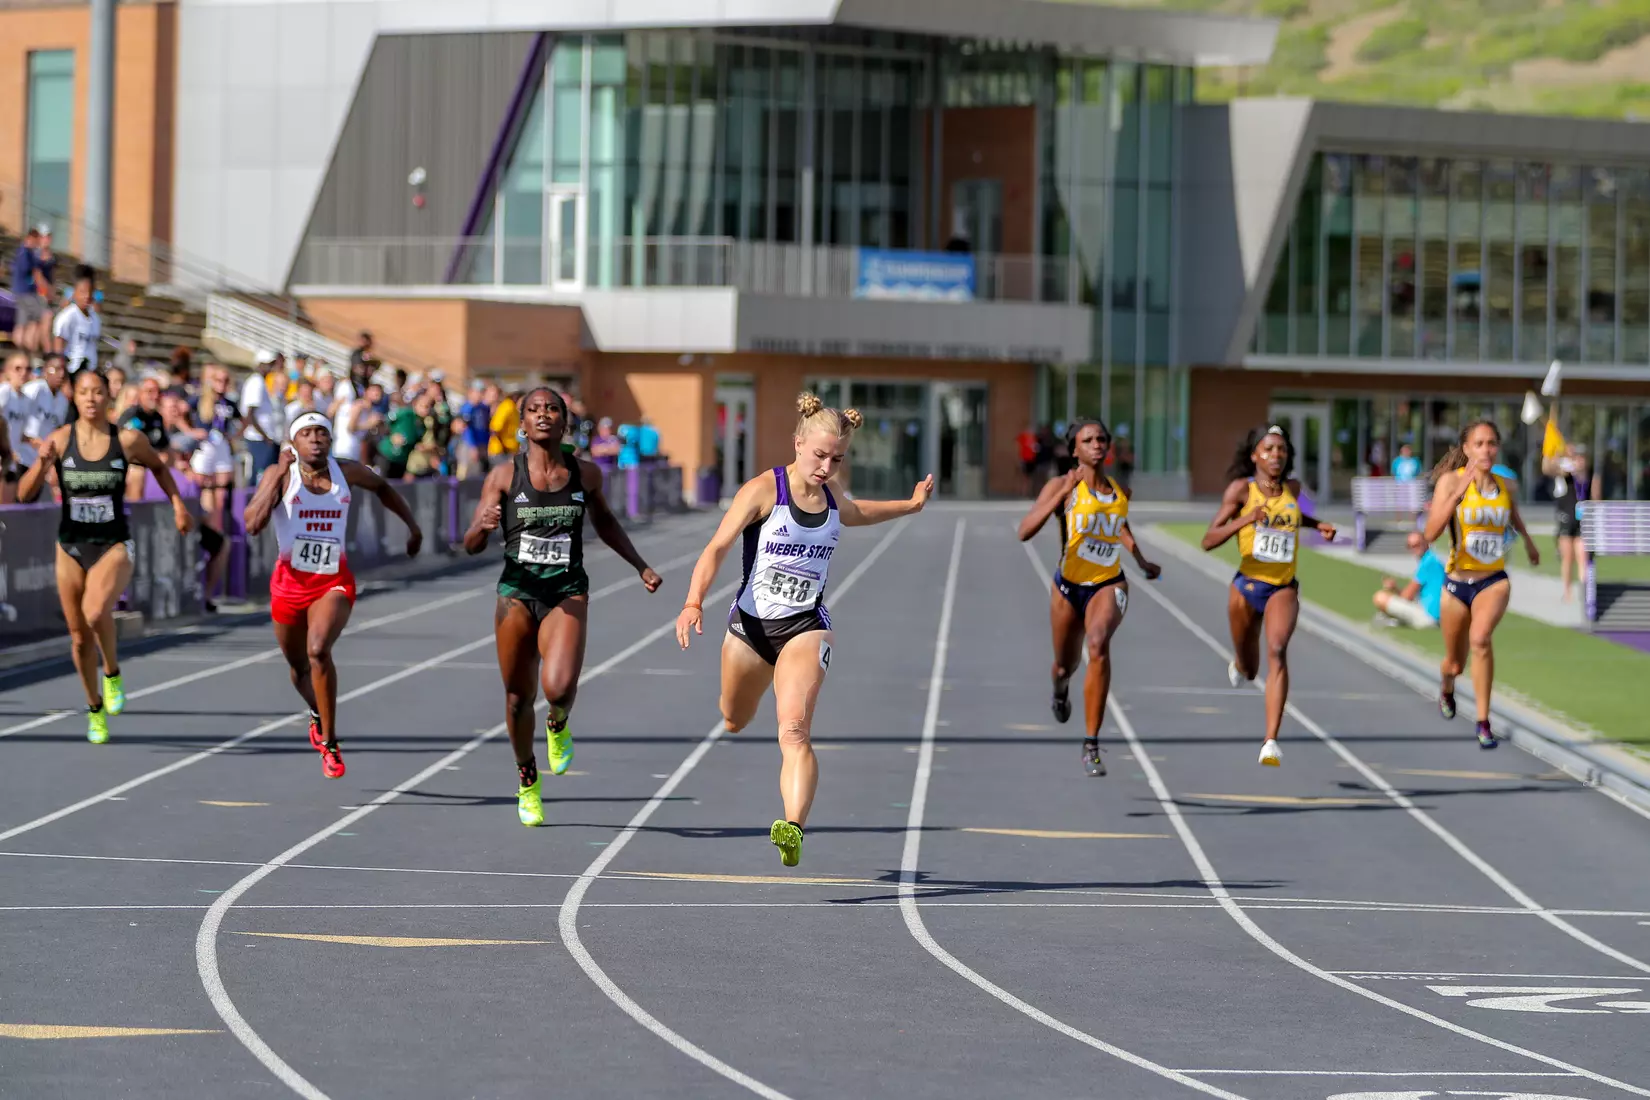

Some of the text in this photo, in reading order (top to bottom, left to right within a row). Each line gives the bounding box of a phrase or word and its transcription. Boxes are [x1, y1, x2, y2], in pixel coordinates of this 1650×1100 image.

[299, 510, 341, 519] SOUTHERN
[517, 505, 583, 518] SACRAMENTO
[306, 522, 333, 532] UTAH
[300, 543, 331, 565] 491
[527, 539, 562, 560] 445
[765, 541, 807, 558] WEBER
[1260, 535, 1289, 557] 364
[1472, 539, 1498, 557] 402
[769, 571, 811, 603] 538
[822, 646, 831, 671] 4
